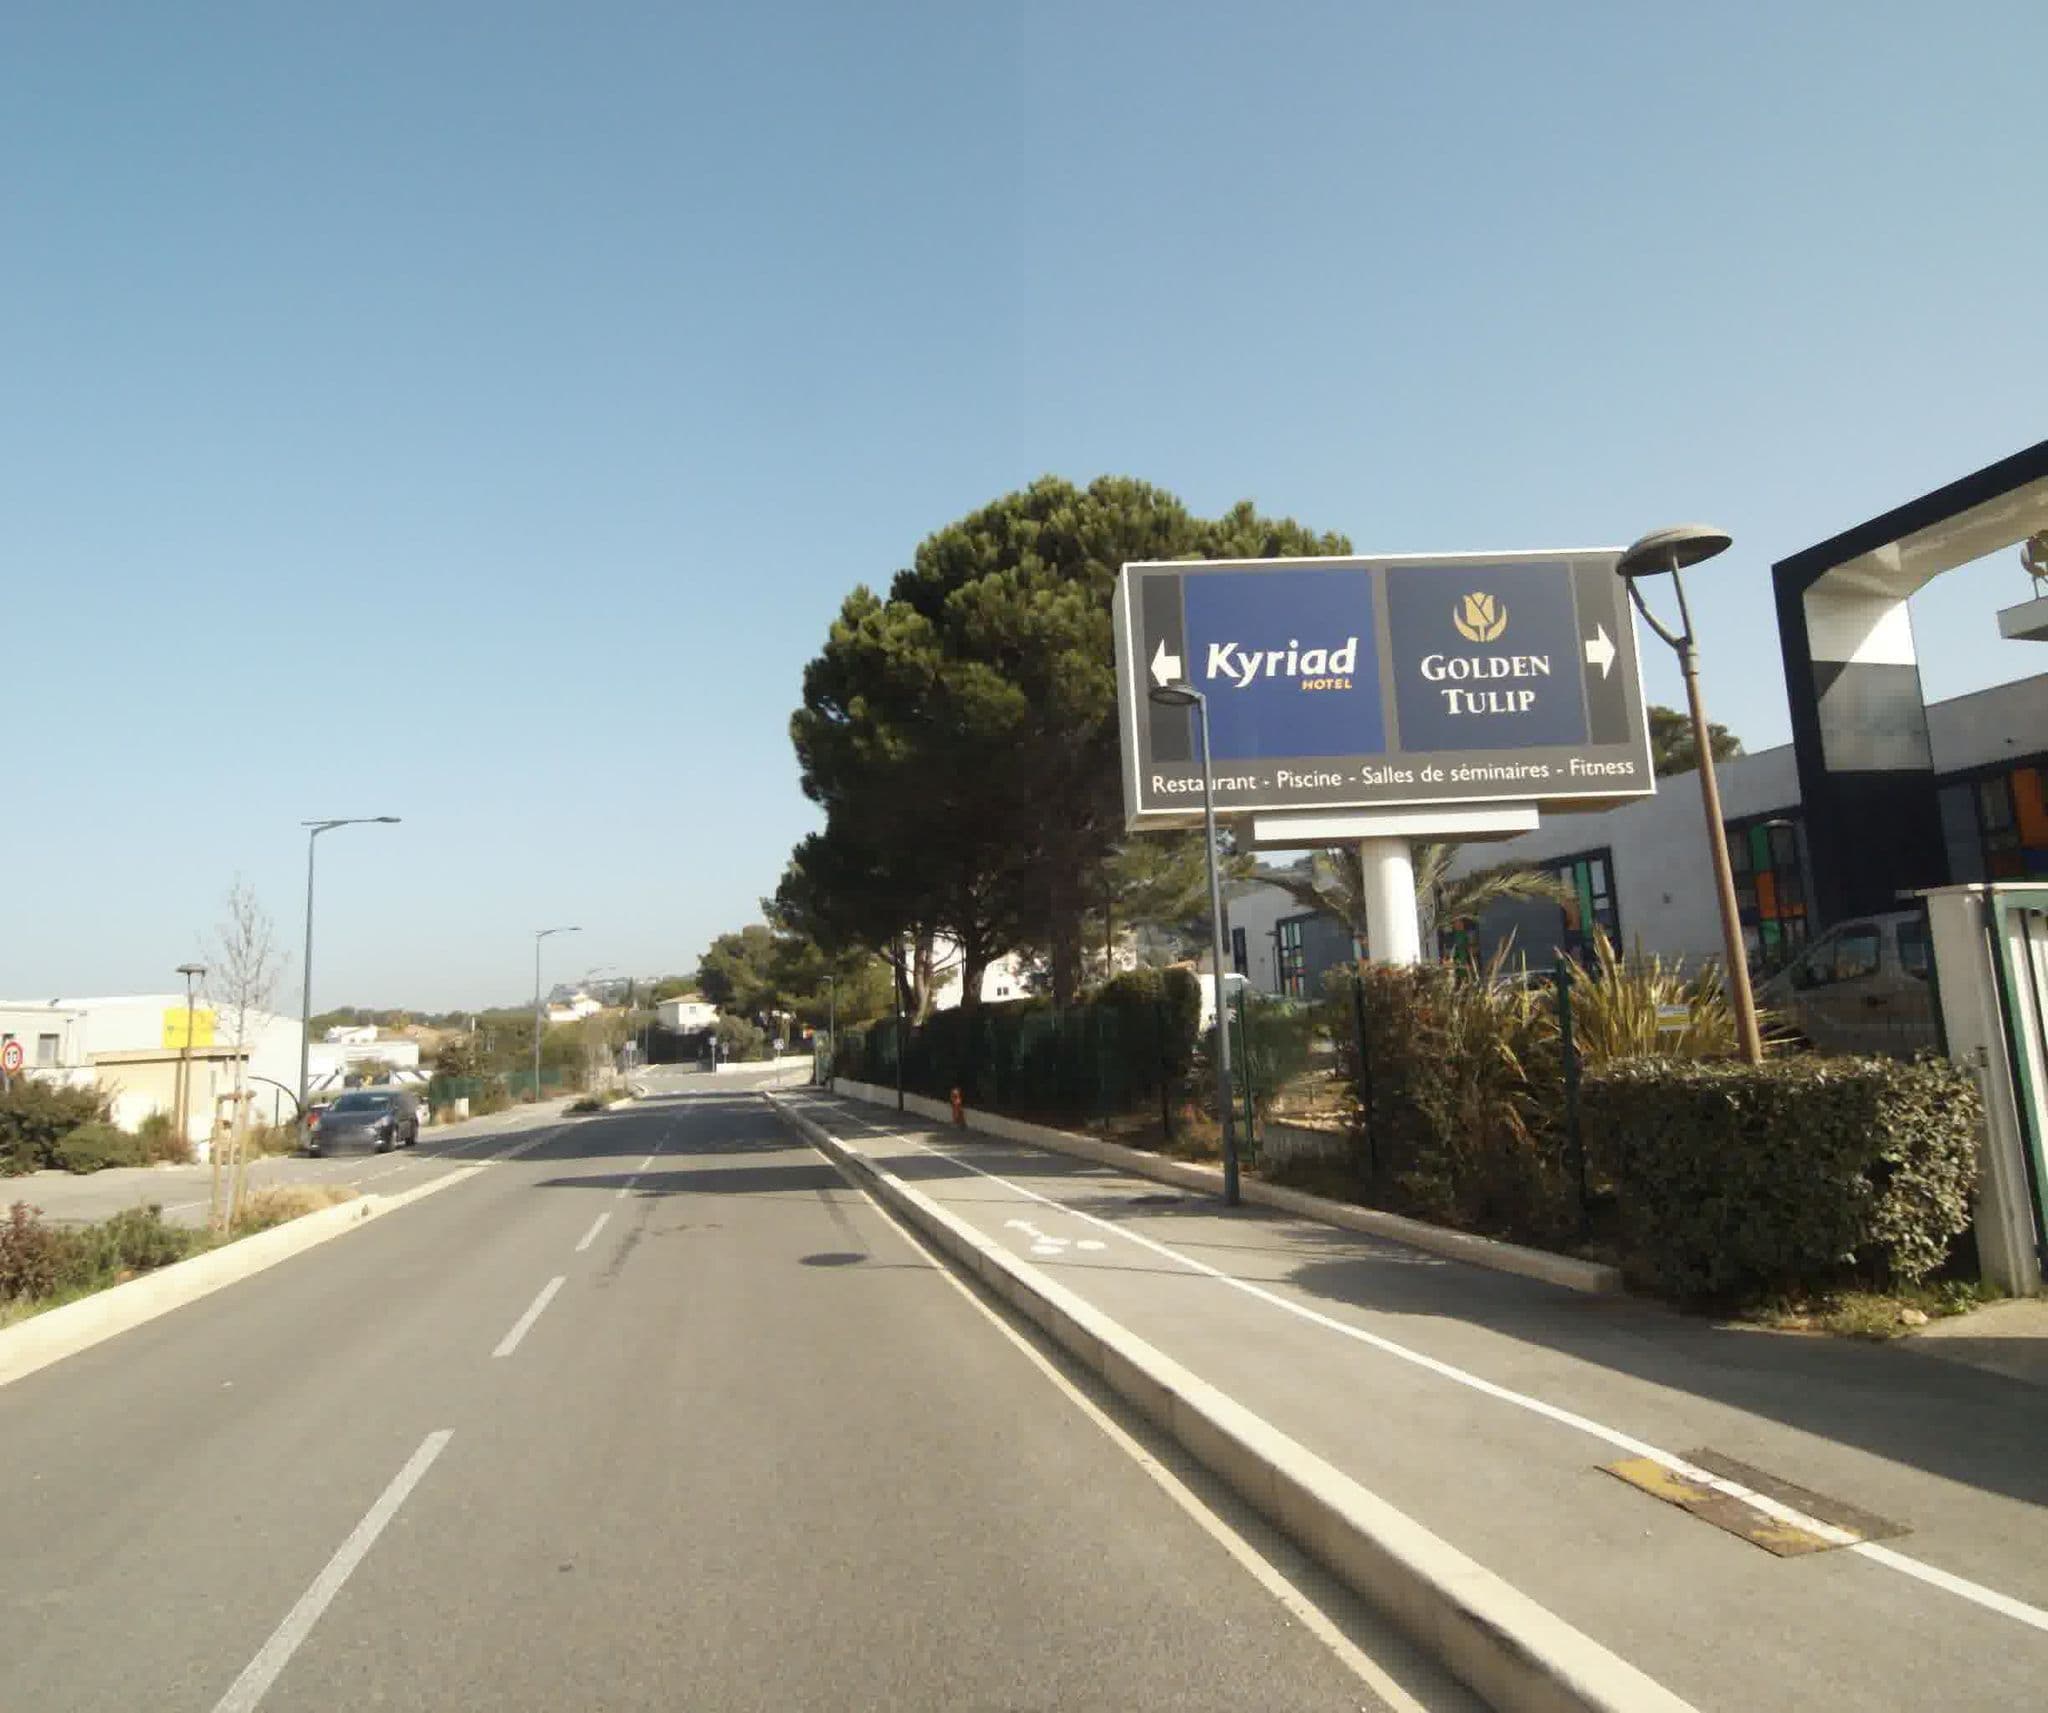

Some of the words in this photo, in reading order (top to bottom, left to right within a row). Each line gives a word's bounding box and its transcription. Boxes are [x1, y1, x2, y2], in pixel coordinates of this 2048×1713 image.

[1206, 636, 1359, 689] Kyriad
[1420, 654, 1551, 681] GOLDEN
[1301, 678, 1353, 691] HOTEL
[1440, 688, 1537, 715] TULIP
[1276, 770, 1342, 789] Piscine
[1361, 765, 1414, 785] Salles
[1420, 764, 1445, 783] de
[1450, 762, 1550, 782] séminaires
[1569, 757, 1636, 777] Fitness
